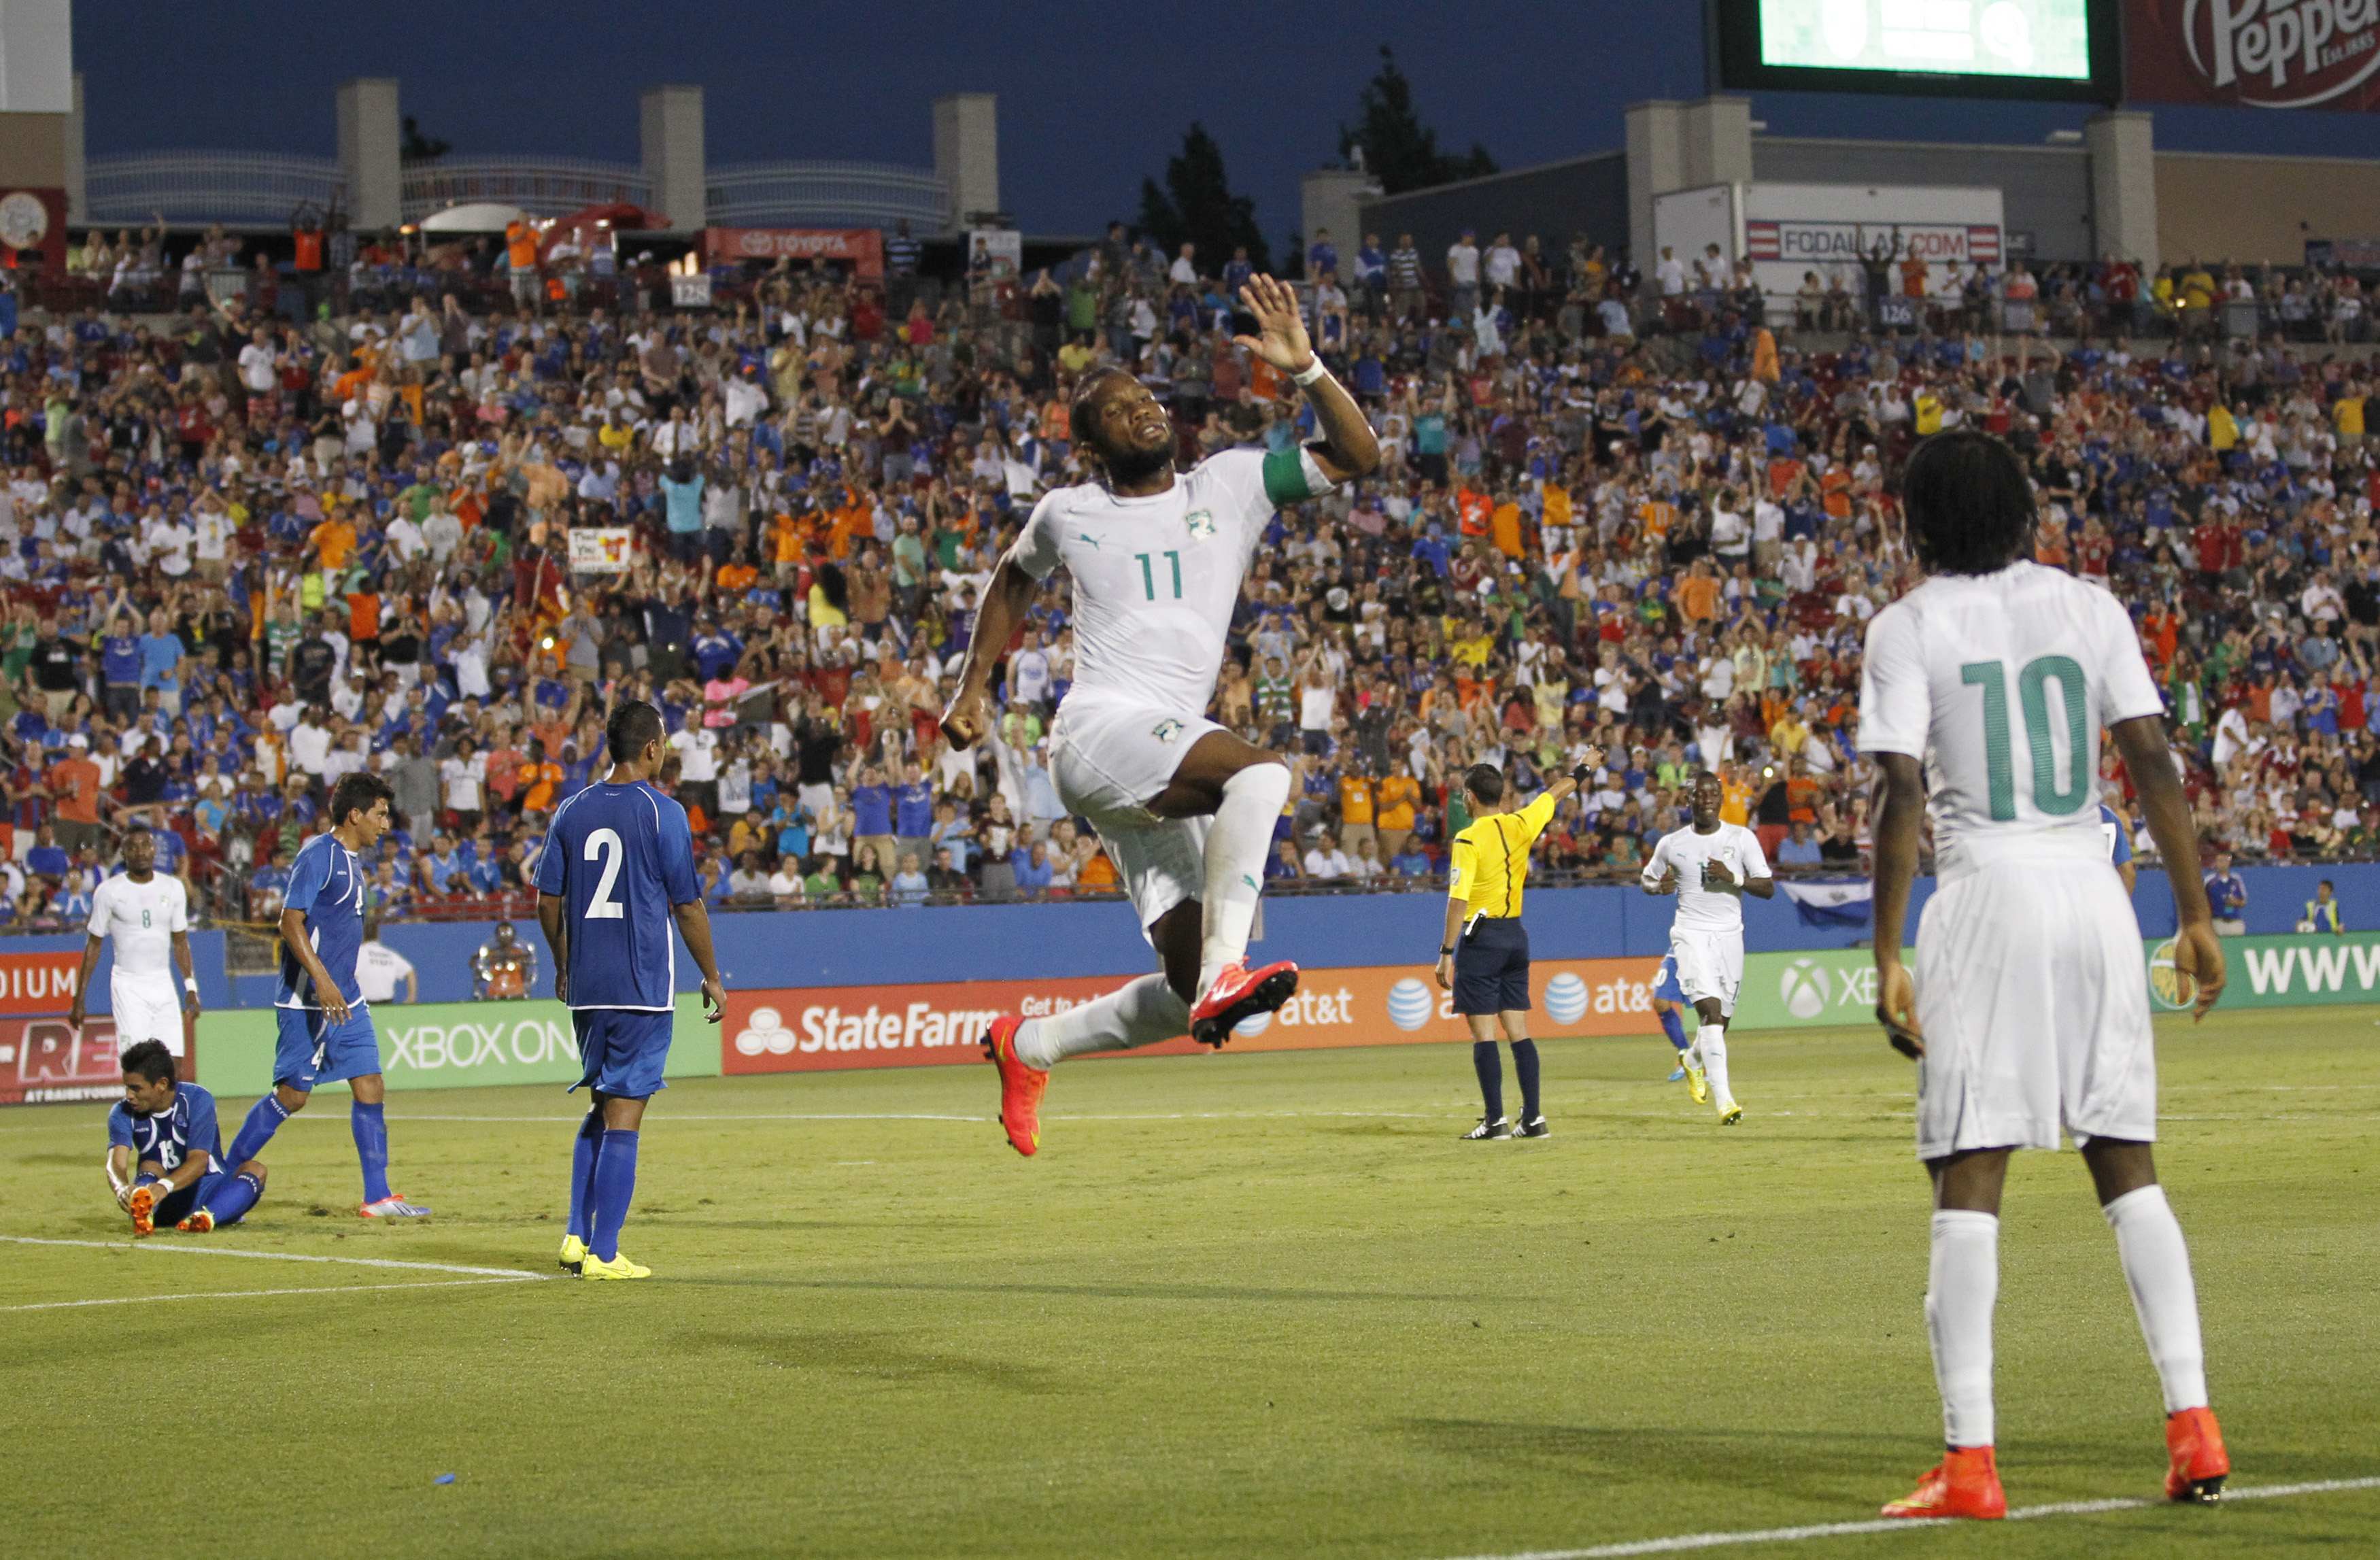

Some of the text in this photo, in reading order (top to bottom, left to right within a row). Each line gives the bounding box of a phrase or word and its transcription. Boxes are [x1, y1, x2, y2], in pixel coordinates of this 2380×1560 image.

[777, 234, 847, 252] TOYOTA
[1882, 305, 1912, 324] 126
[1134, 550, 1182, 601] 11
[1960, 655, 2089, 821] 10
[583, 828, 624, 919] 2
[141, 909, 152, 929] 8
[2244, 943, 2380, 995] WWW
[1021, 996, 1051, 1017] Get
[1278, 988, 1353, 1025] at&t
[1594, 977, 1656, 1014] at&
[311, 1042, 326, 1072] 4
[386, 1020, 578, 1070] XBOX ON
